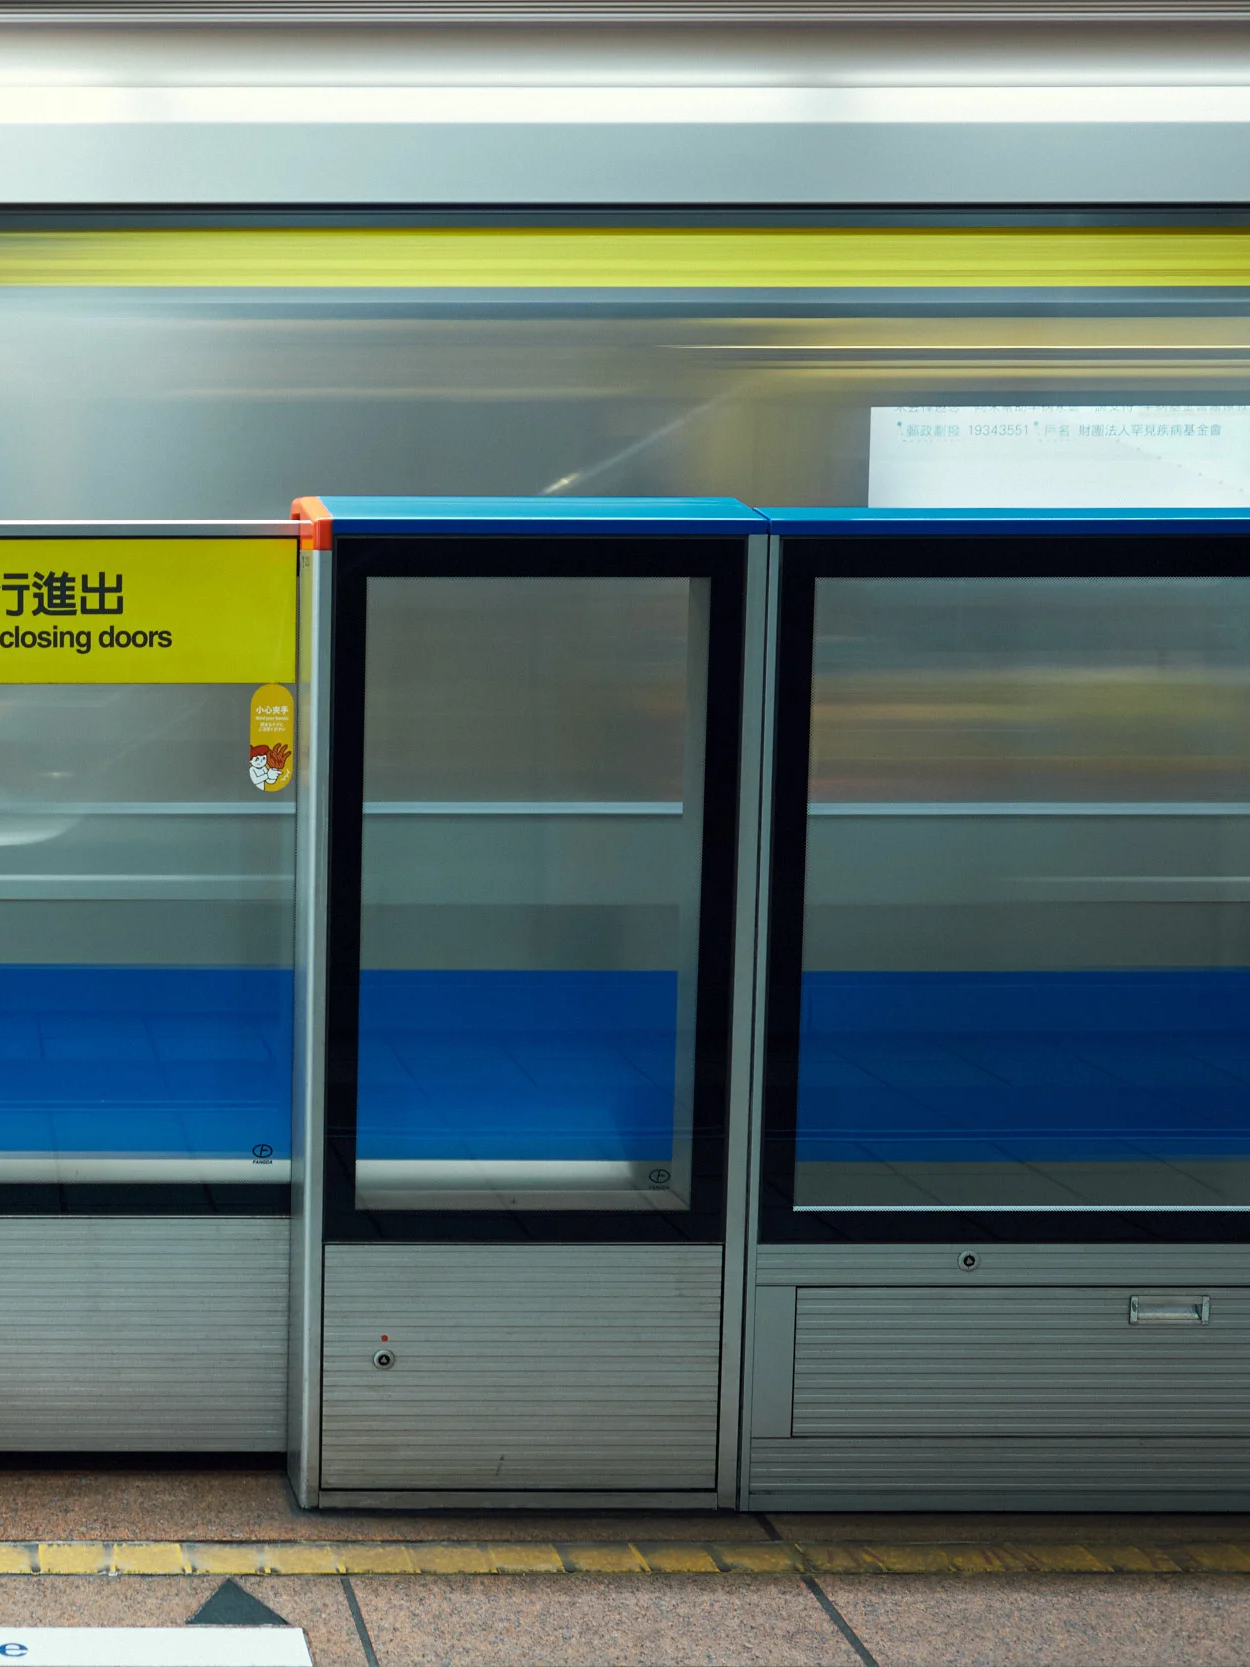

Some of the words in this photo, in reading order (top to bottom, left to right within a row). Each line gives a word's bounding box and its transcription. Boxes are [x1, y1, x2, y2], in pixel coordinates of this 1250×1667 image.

[968, 424, 1029, 437] 19343551
[1078, 423, 1222, 437] 財團法人罕見疾病基金會
[0, 625, 92, 655] closing
[98, 625, 172, 649] doors
[256, 705, 289, 714] 小心夾手
